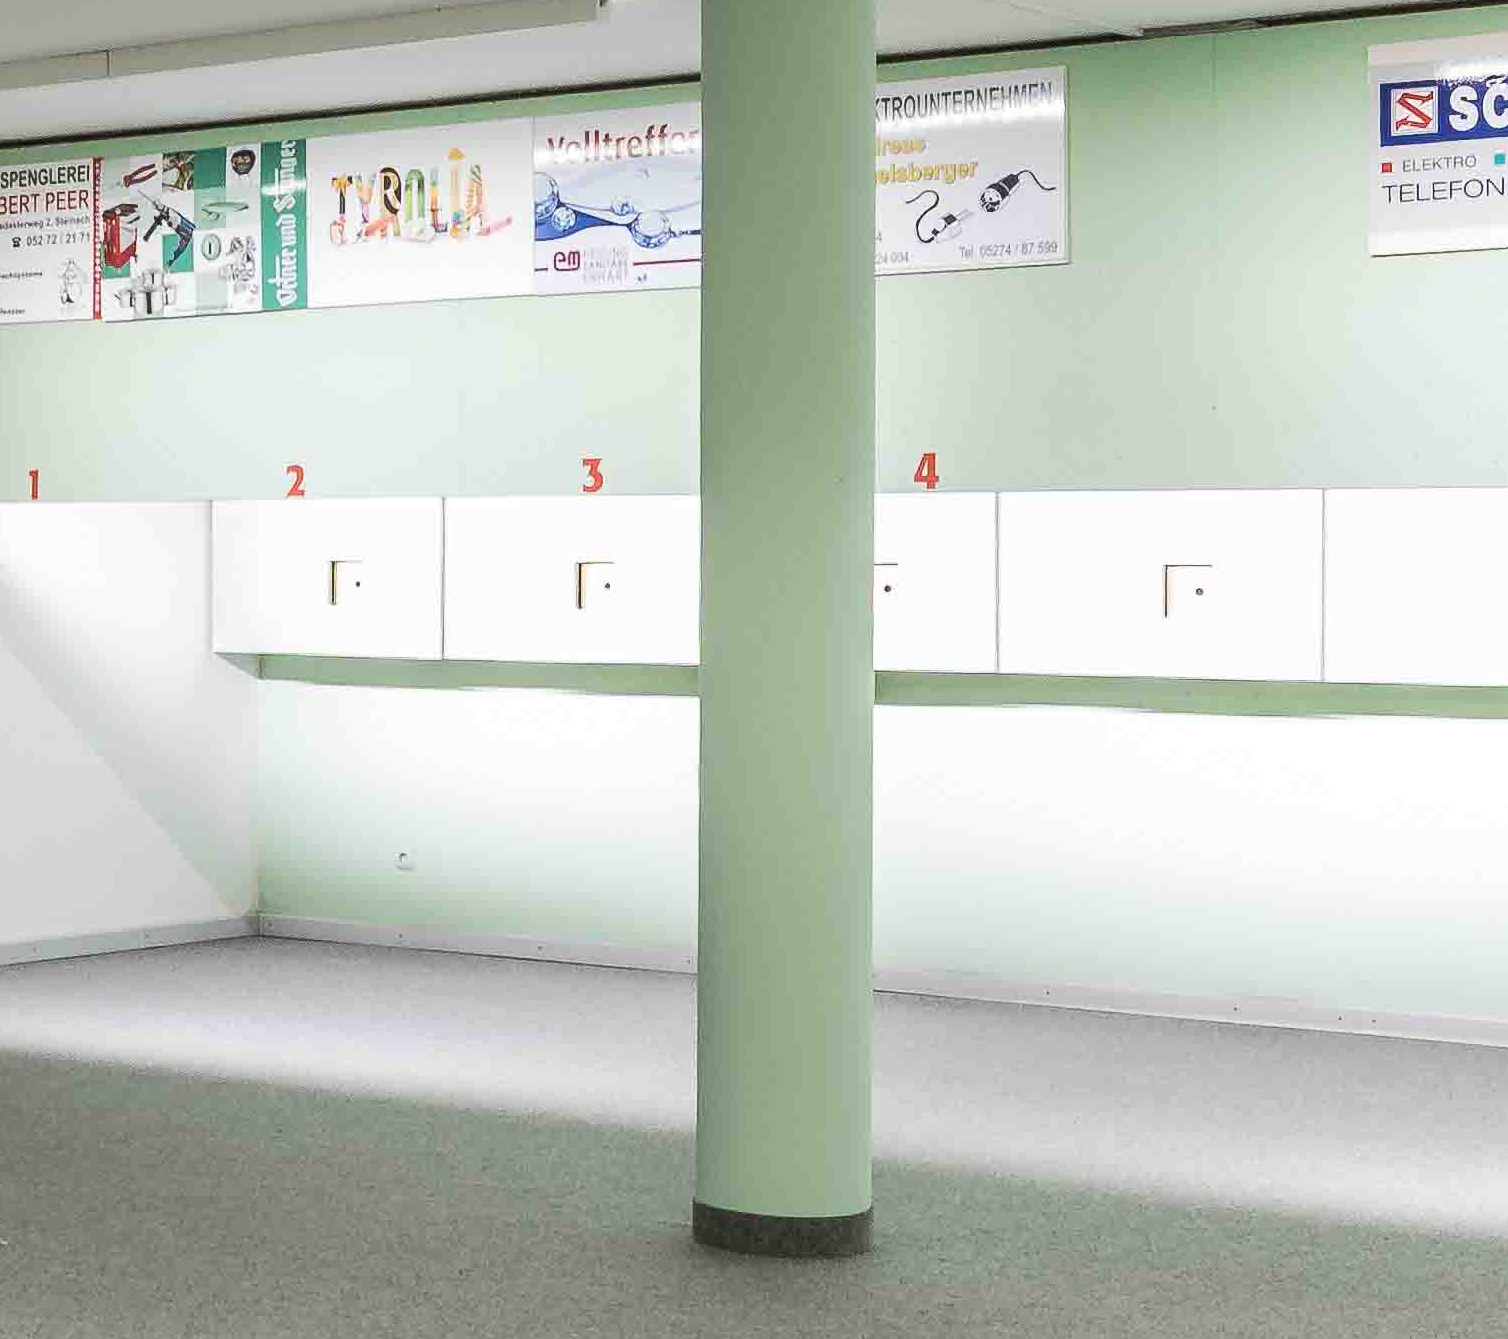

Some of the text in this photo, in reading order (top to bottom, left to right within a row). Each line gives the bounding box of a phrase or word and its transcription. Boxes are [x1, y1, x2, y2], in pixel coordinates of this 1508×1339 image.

[0, 165, 90, 189] SPENGLEREI
[1402, 155, 1477, 173] ELEKTRO
[45, 189, 89, 212] PEER
[980, 244, 1011, 258] 05274
[286, 465, 306, 498] 2
[583, 459, 603, 493] 3
[915, 452, 938, 488] 4
[30, 470, 38, 500] 1
